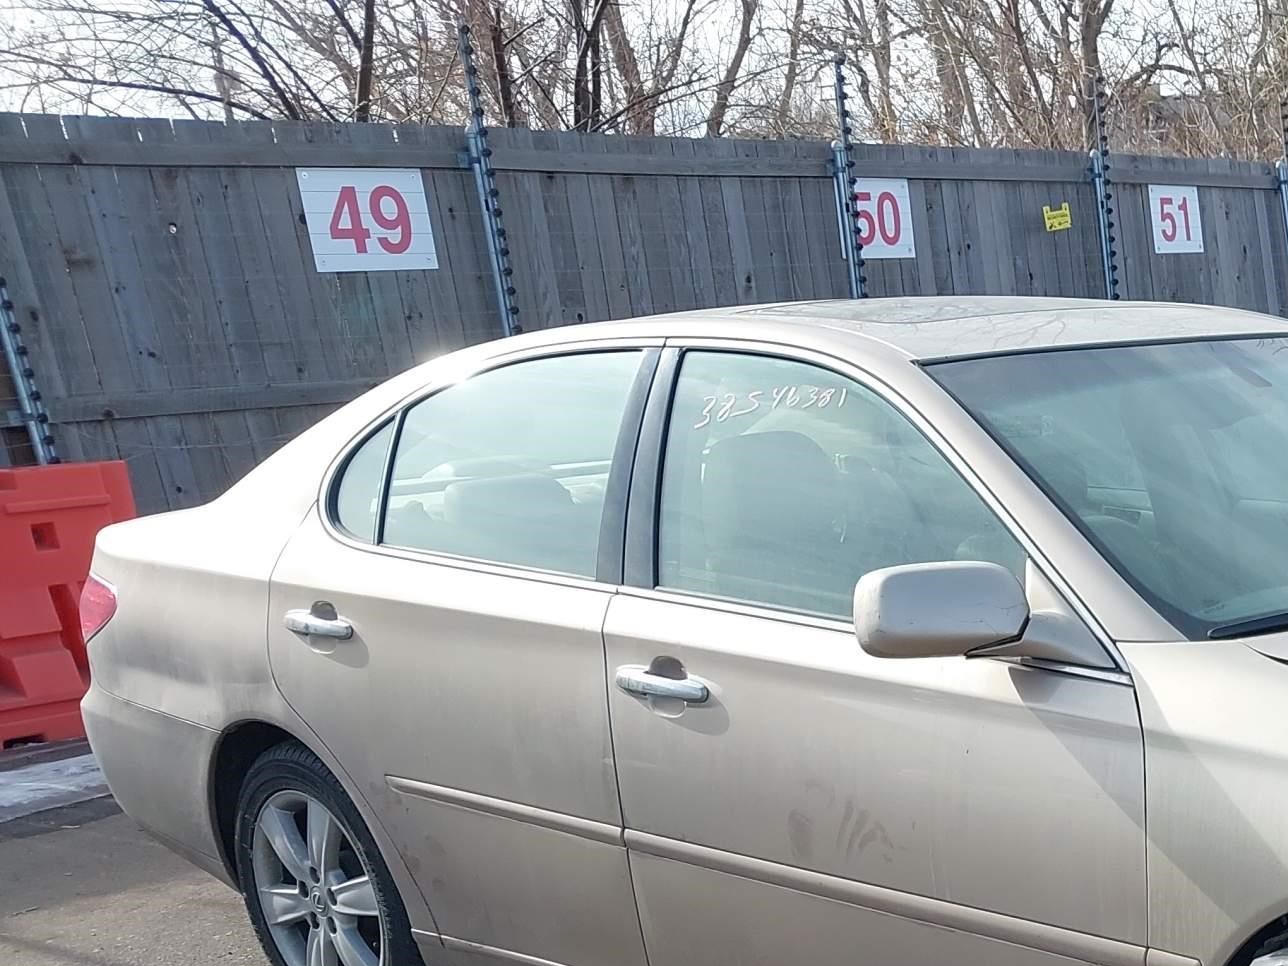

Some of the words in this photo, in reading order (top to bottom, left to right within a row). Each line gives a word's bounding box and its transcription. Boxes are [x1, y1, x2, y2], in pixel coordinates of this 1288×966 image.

[329, 185, 412, 254] 49
[854, 191, 901, 246] 50
[1159, 196, 1192, 242] 51
[694, 385, 847, 429] 38546381
